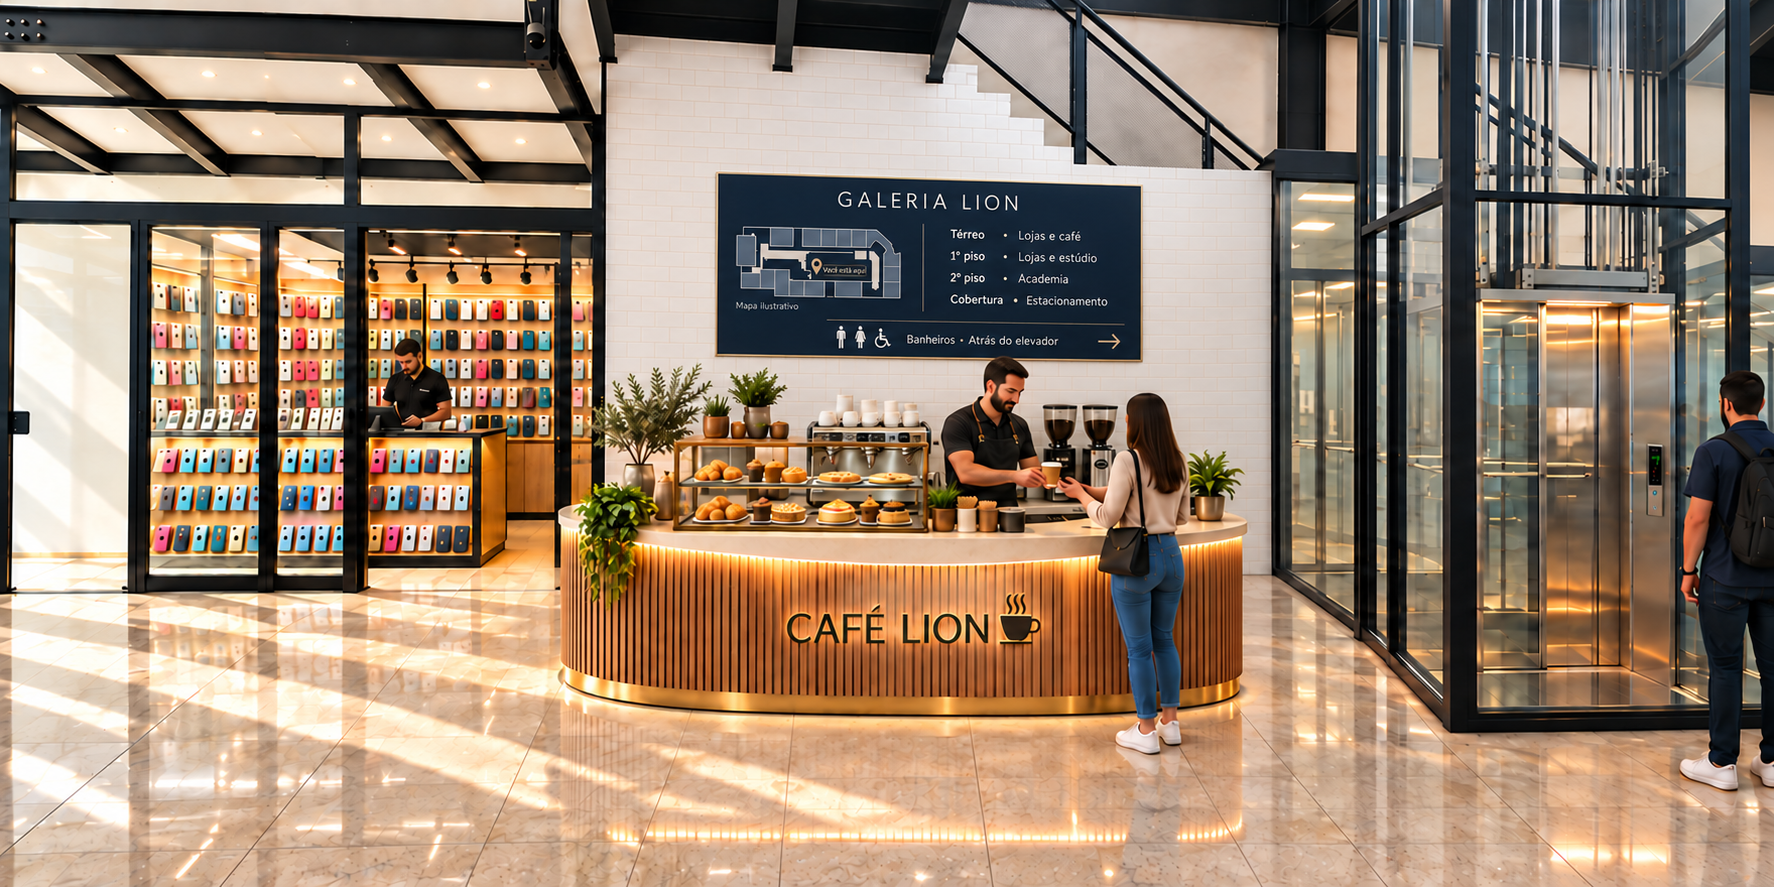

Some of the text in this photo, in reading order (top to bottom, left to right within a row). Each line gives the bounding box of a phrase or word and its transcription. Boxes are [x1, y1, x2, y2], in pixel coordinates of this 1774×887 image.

[838, 191, 1018, 211] GALERIA LION
[950, 229, 985, 239] Térreo
[1019, 231, 1045, 242] Lojas
[1059, 231, 1081, 241] café
[964, 251, 985, 263] piso
[1019, 252, 1045, 264] Lojas
[1059, 253, 1097, 263] estúdio
[964, 273, 985, 284] piso
[1018, 274, 1068, 284] Academia
[950, 294, 1108, 306] Cobertura Estacionamento
[735, 302, 798, 311] Mapa ilustrativo
[907, 335, 1058, 345] Banheiros Atrás do elevador
[786, 604, 989, 644] CAFÉ LION
